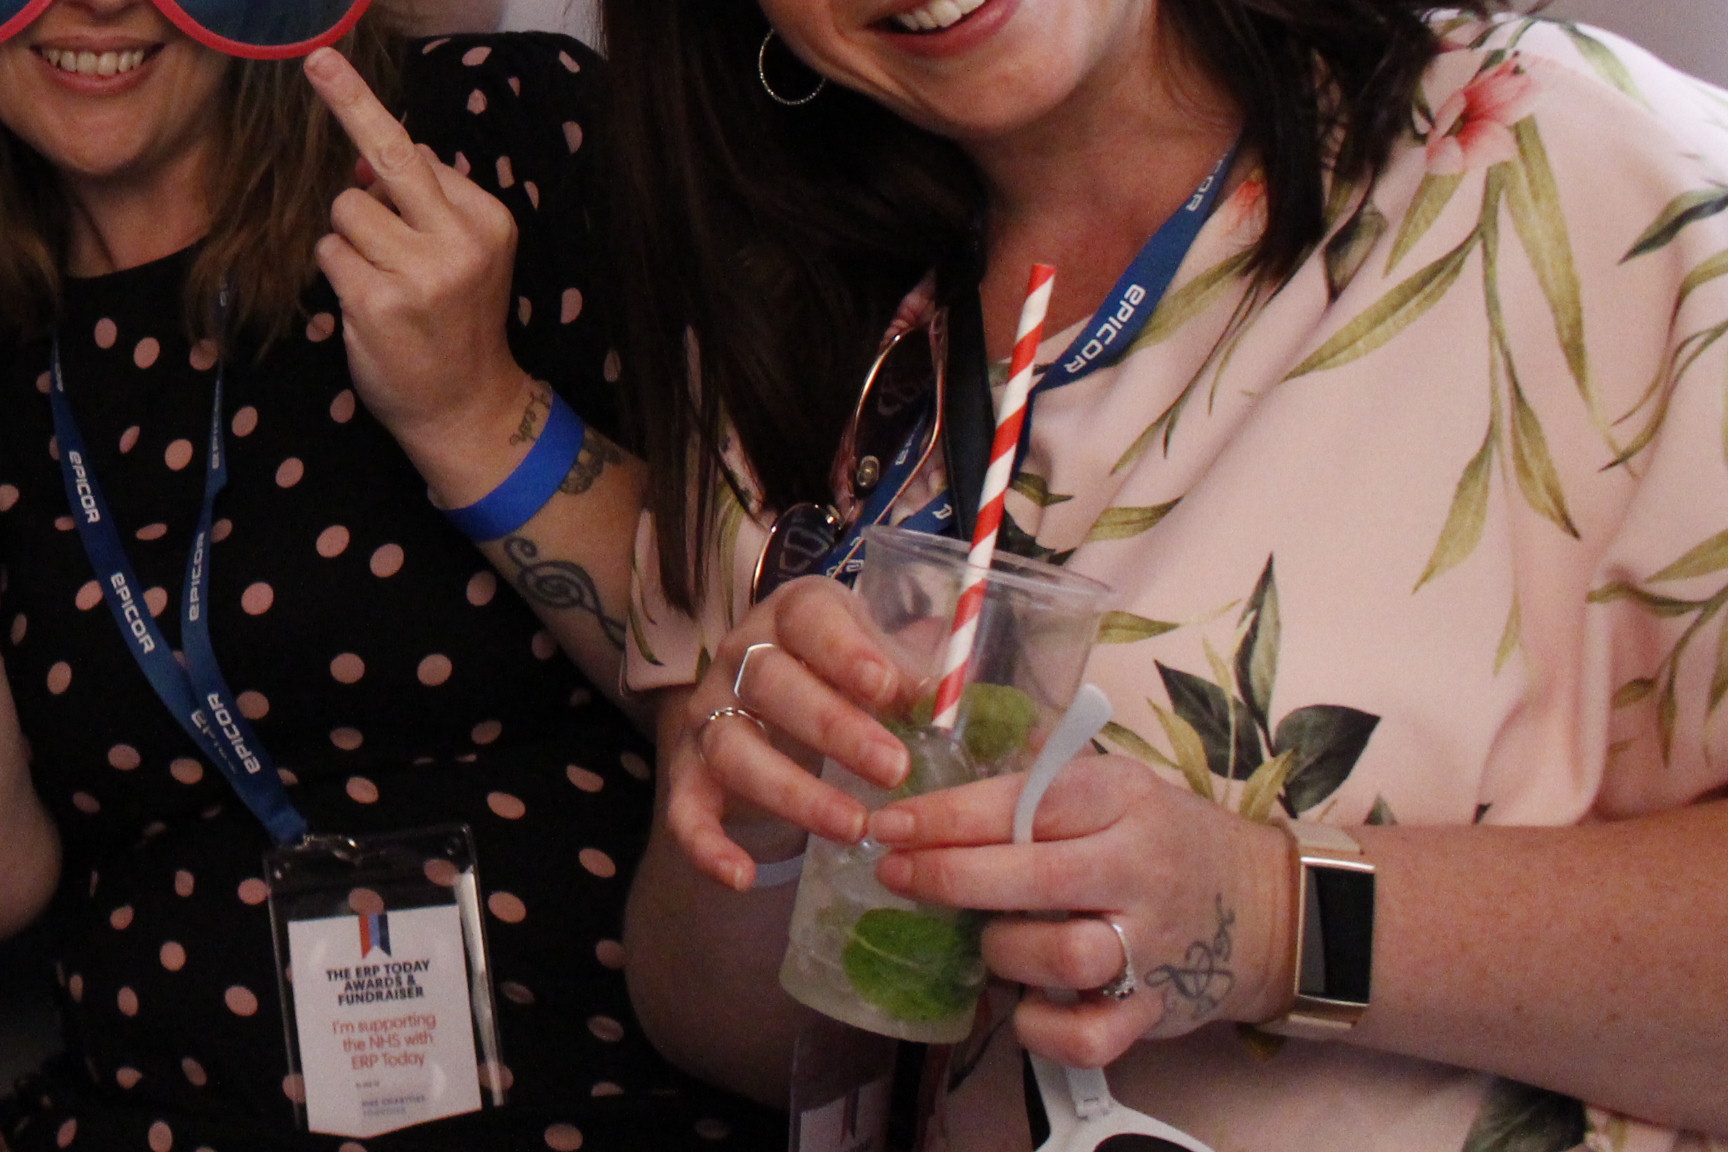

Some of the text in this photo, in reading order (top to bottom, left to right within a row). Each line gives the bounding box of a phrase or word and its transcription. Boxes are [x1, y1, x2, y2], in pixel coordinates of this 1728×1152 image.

[326, 959, 430, 981] THE ERP TODAY
[344, 974, 416, 992] AWARDS &
[338, 986, 424, 1006] FUNDRAISER
[333, 1014, 436, 1035] I'm supporting
[343, 1030, 433, 1052] the NHS with
[351, 1050, 424, 1070] ERP Today
